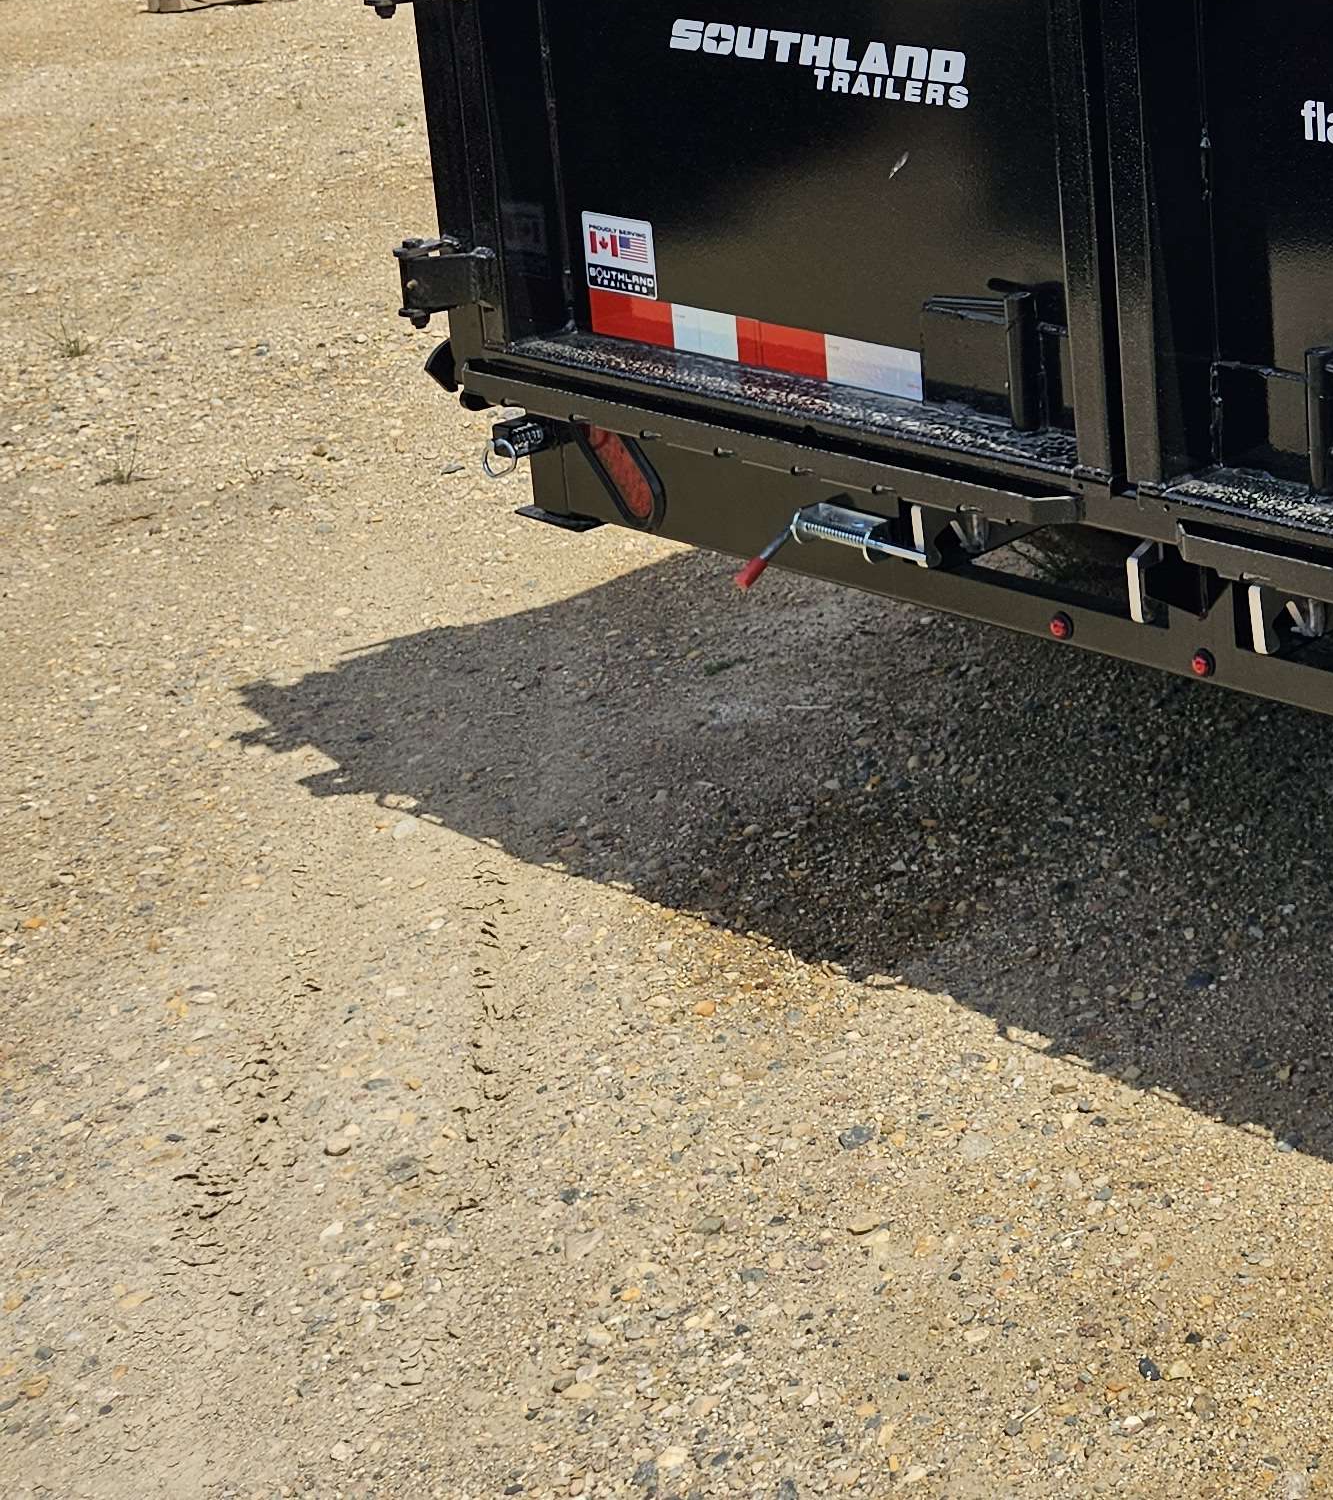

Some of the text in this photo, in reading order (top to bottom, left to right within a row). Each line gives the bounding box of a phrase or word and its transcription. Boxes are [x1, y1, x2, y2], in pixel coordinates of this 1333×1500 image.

[669, 19, 966, 84] SOUTHLAND
[813, 68, 969, 109] TRAILERS
[589, 267, 654, 288] SOUTHLAND
[596, 278, 648, 294] TRAILERS
